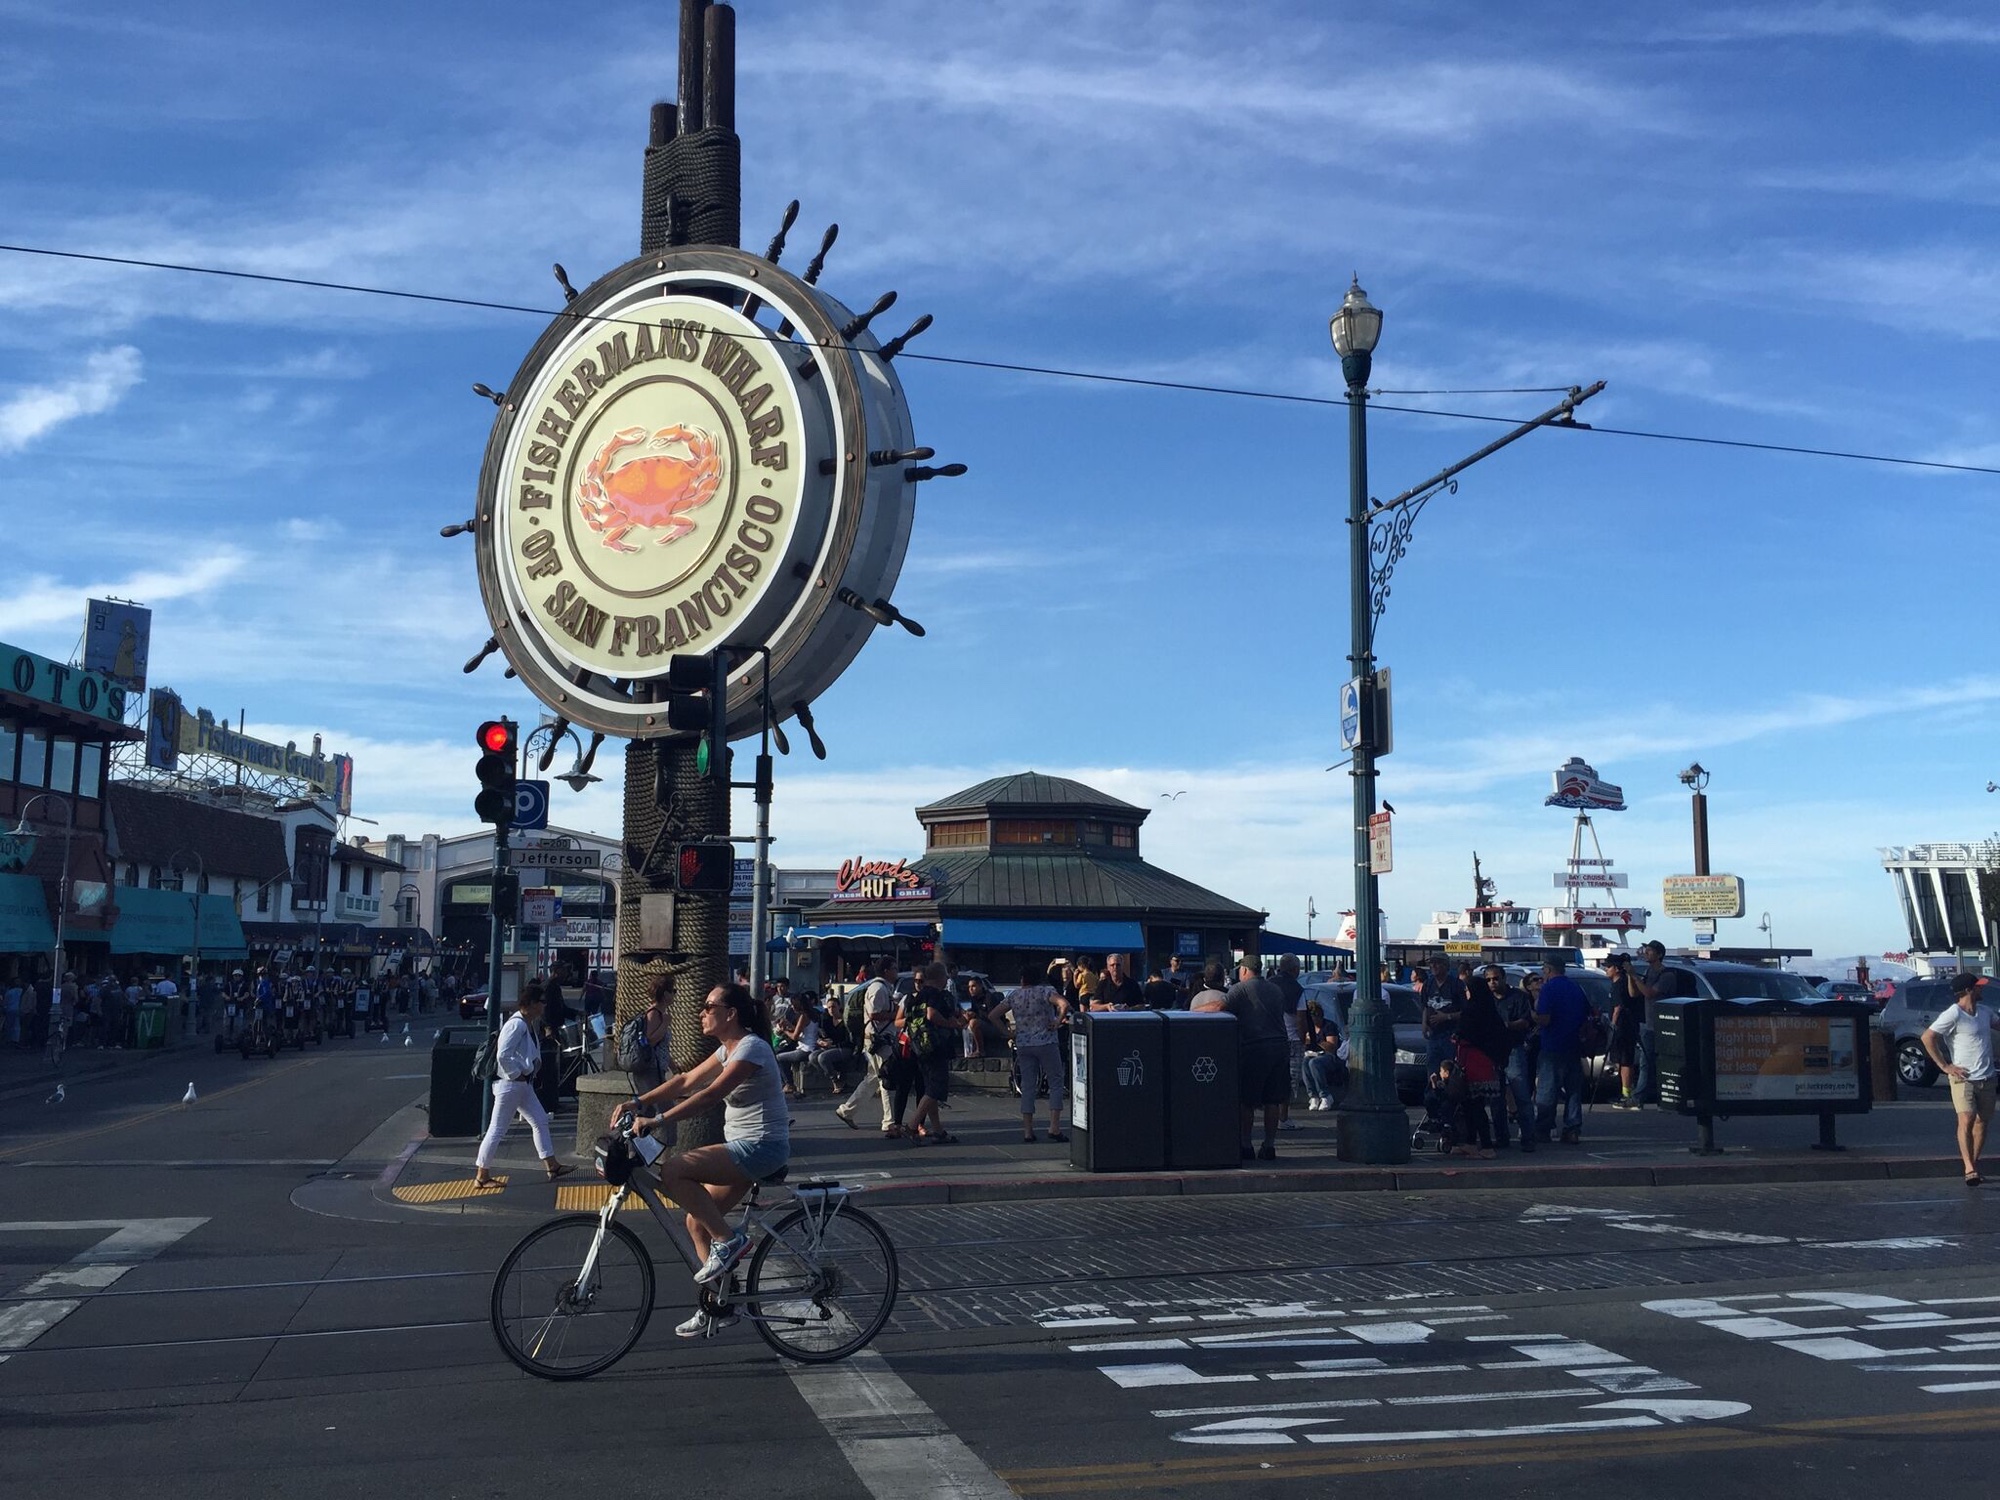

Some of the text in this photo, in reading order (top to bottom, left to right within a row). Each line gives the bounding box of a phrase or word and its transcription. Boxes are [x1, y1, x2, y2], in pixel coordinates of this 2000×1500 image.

[519, 317, 790, 512] FISHERMANS WHARF
[520, 493, 784, 657] OF SAN FRANCISCO
[13, 654, 126, 721] OTO'S
[519, 852, 592, 865] Jefferson
[836, 855, 920, 892] Chowder
[860, 878, 896, 899] HUT
[899, 889, 929, 897] GRILL
[1714, 1016, 1734, 1028] The
[1738, 1016, 1761, 1028] best
[1804, 1017, 1821, 1030] do.
[1714, 1031, 1744, 1045] Right
[1715, 1046, 1773, 1060] Right now.
[1715, 1062, 1734, 1072] For
